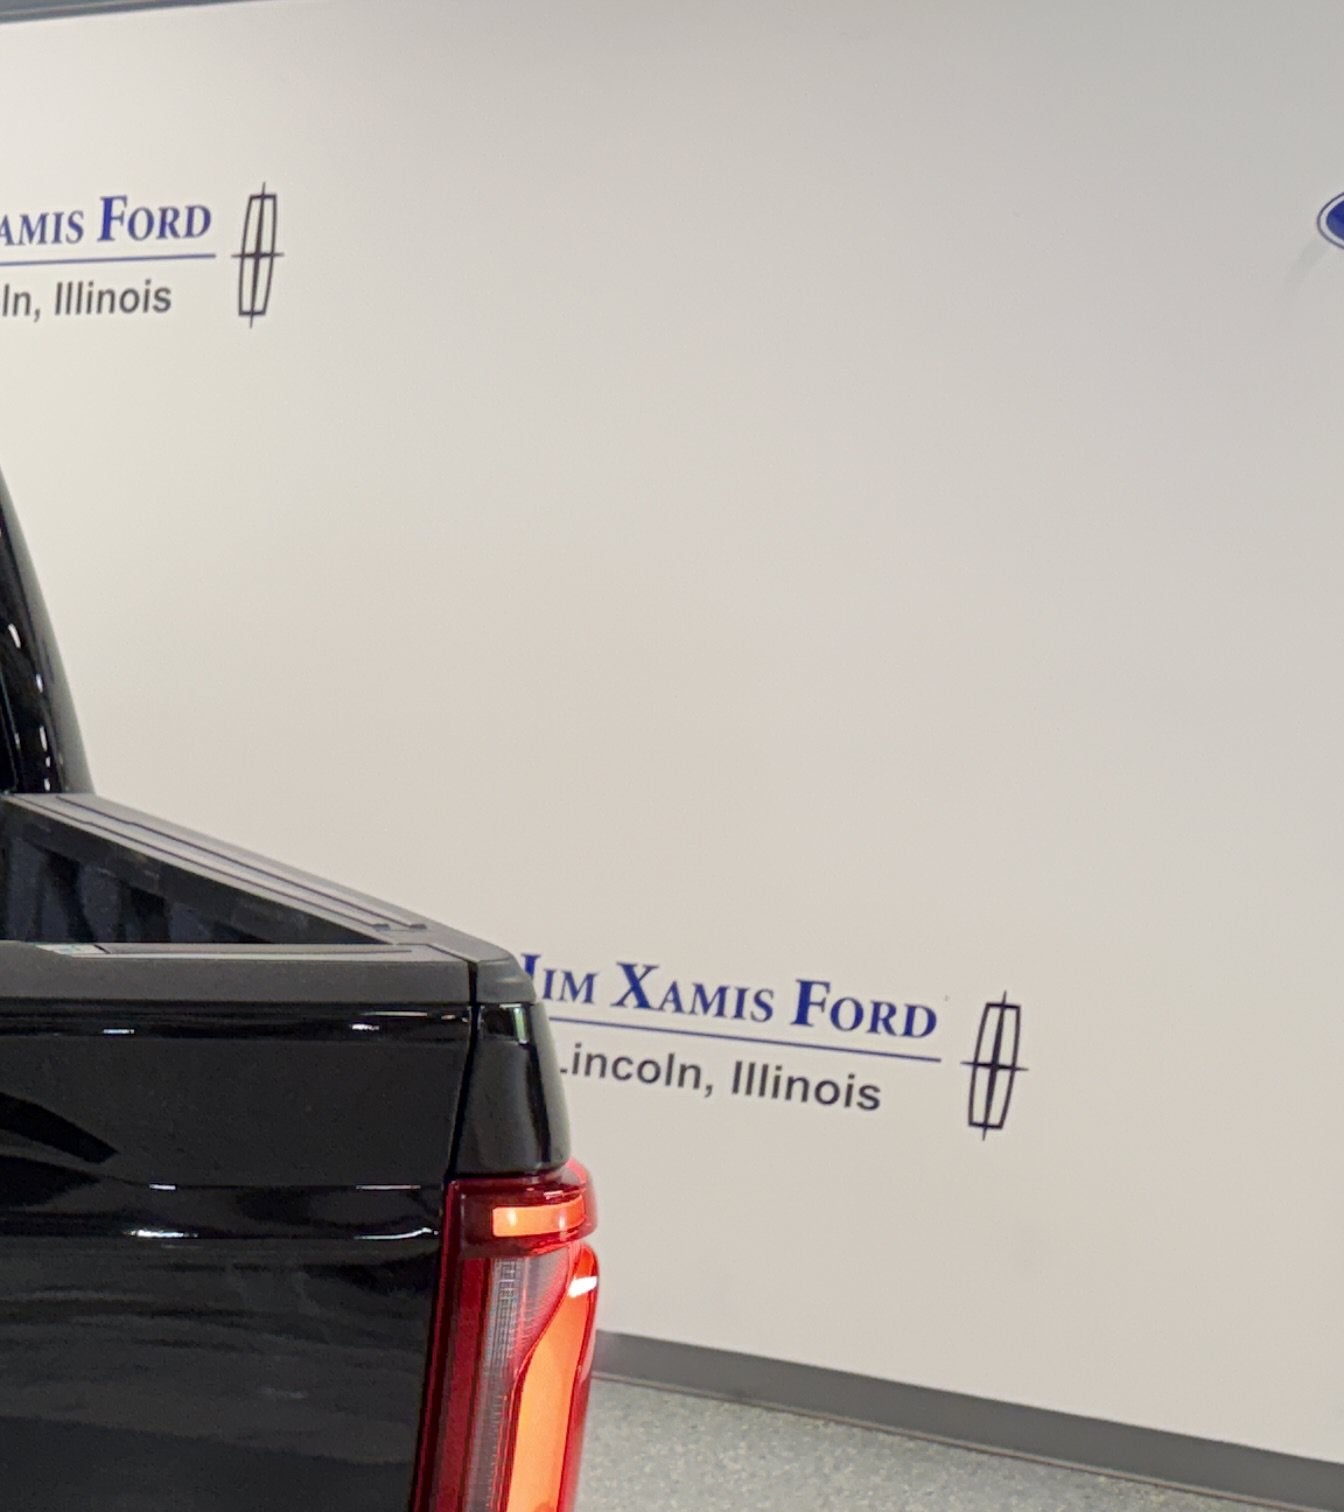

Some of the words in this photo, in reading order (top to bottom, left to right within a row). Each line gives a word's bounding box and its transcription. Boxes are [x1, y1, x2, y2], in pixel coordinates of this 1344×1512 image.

[97, 195, 211, 242] FORD
[54, 279, 172, 316] Illinois
[610, 961, 774, 1023] XAMIS
[790, 978, 937, 1039] FORD
[560, 1042, 713, 1097] incoln,
[731, 1059, 881, 1111] Illinois
